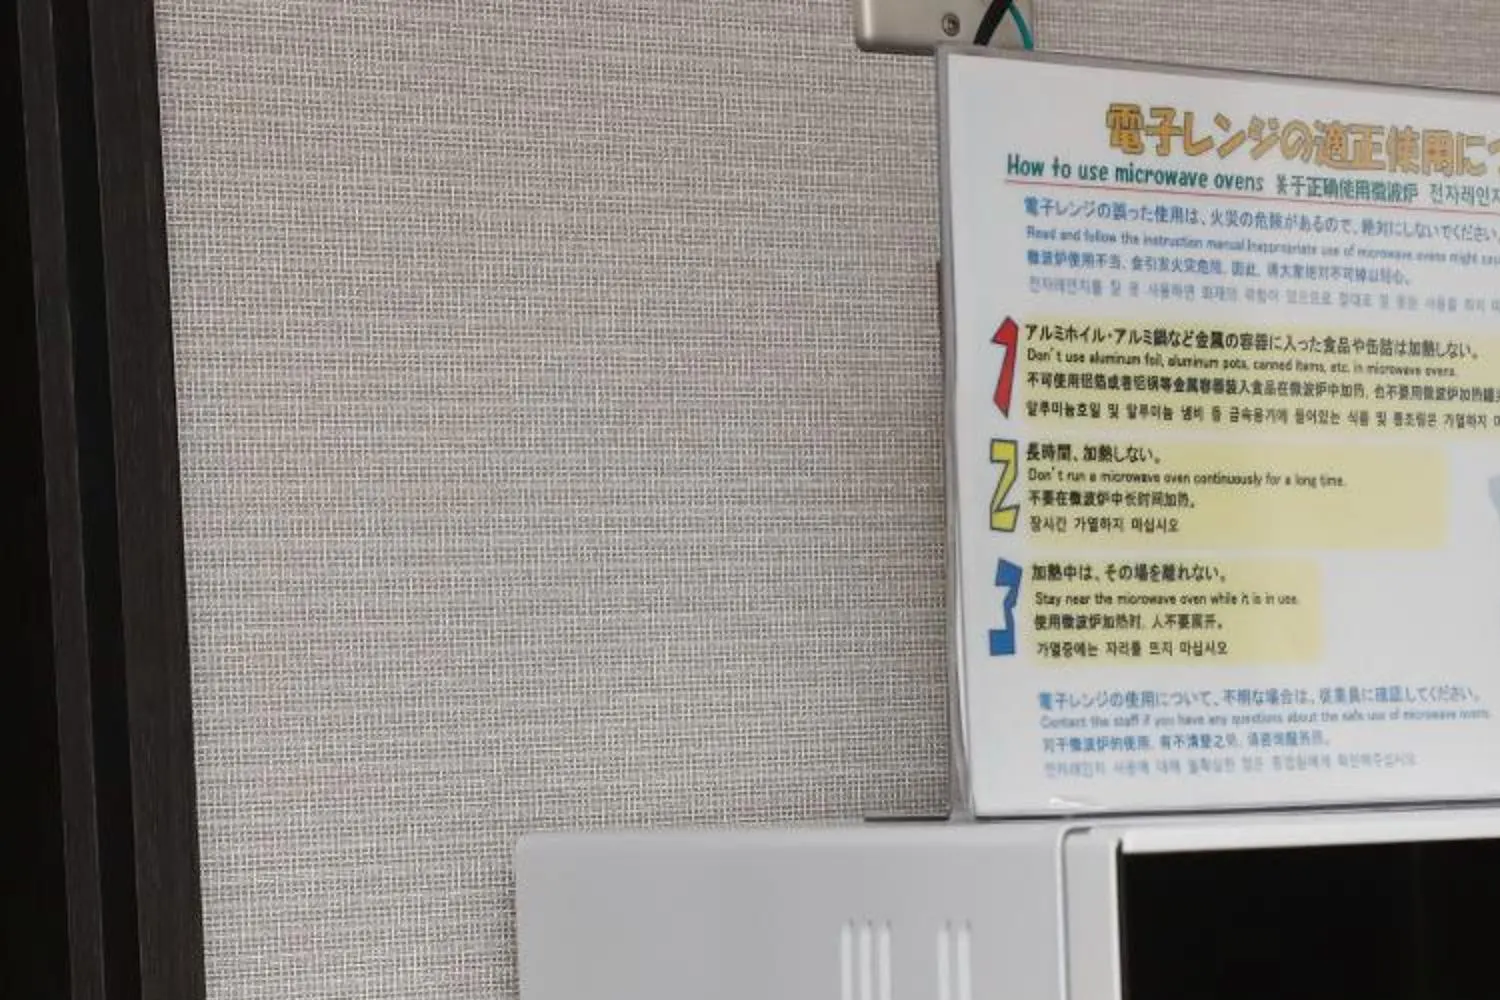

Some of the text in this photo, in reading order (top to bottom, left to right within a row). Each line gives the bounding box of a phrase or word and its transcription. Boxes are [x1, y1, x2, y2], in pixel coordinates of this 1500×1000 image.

[1007, 153, 1264, 192] How to use microwave ovens
[1026, 225, 1056, 240] Read
[1060, 229, 1081, 242] and
[1084, 228, 1117, 243] follow
[1121, 231, 1140, 245] the
[1144, 232, 1202, 249] instruction
[1344, 244, 1354, 257] of
[1357, 248, 1412, 261] microwave
[991, 316, 1018, 419] 1
[1065, 353, 1085, 364] use
[1089, 352, 1141, 366] aluminum
[1168, 354, 1219, 369] aluminum
[1253, 357, 1292, 371] canned
[1353, 362, 1363, 374] in
[1367, 362, 1421, 376] microwave
[1026, 442, 1161, 464] 長時間、加熱しない。
[989, 438, 1020, 532] 2
[1067, 471, 1087, 484] run
[1089, 473, 1097, 484] a
[1100, 471, 1161, 484] microwave
[1164, 473, 1191, 485] oven
[1193, 471, 1262, 489] continuously
[1265, 472, 1281, 487] for
[1285, 476, 1292, 487] a
[1295, 475, 1317, 489] long
[1074, 515, 1124, 533] 가열하지
[1131, 516, 1179, 533] 마십시오
[1031, 563, 1227, 583] 加熱中は、その場を離れない。
[1035, 592, 1062, 608] Stay
[1065, 593, 1091, 606] near
[1095, 592, 1113, 606] the
[1117, 592, 1176, 605] microwave
[1180, 593, 1207, 606] oven
[1210, 592, 1237, 606] while
[1240, 592, 1249, 606] it
[1265, 592, 1275, 605] in
[1180, 641, 1228, 657] 마십시오
[1114, 713, 1139, 727] staff
[1155, 716, 1175, 729] you
[1177, 713, 1204, 726] have
[1287, 712, 1317, 724] about
[1320, 711, 1339, 723] the
